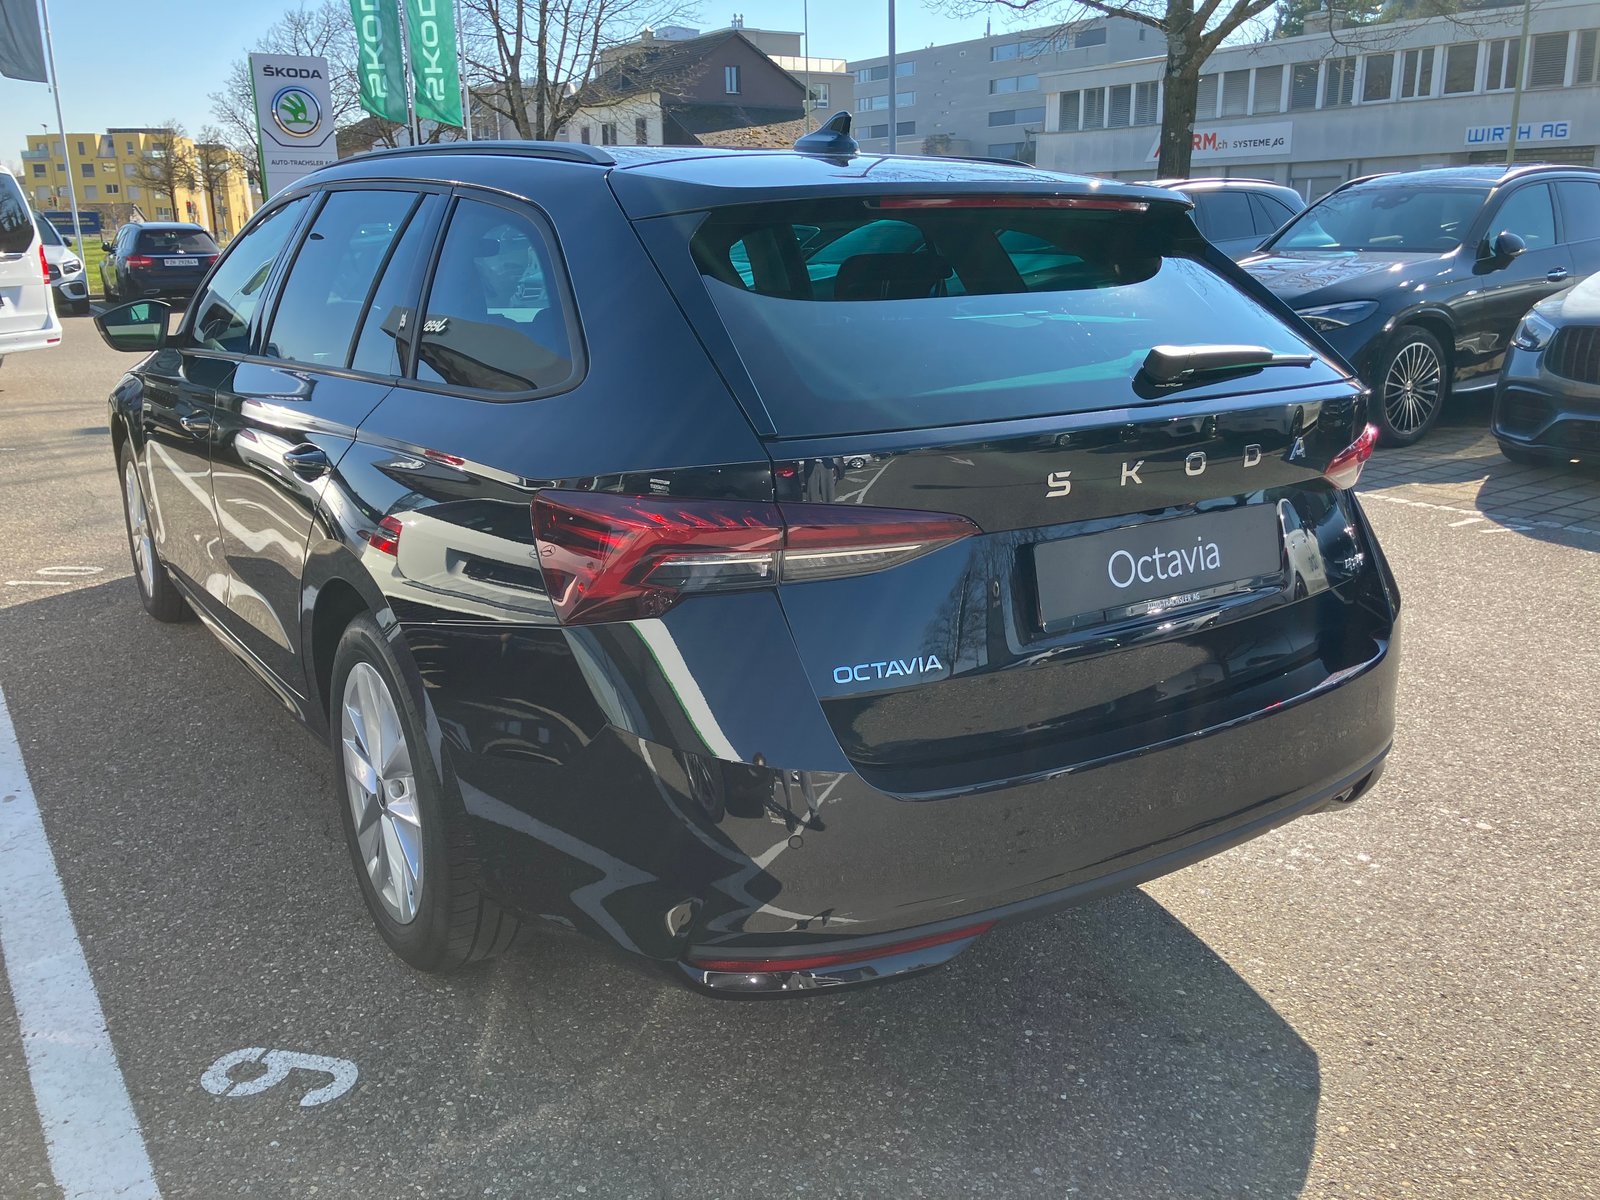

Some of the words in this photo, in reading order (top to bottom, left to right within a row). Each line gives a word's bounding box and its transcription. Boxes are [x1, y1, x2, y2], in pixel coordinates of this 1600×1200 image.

[263, 64, 322, 79] ŠKODA
[1541, 123, 1568, 138] AG
[1233, 138, 1271, 148] SYSTEME
[1271, 137, 1285, 148] AG
[271, 159, 324, 167] AUTO-TRACHSLER
[1107, 536, 1221, 589] Octavia
[833, 655, 943, 684] OCTAVIA
